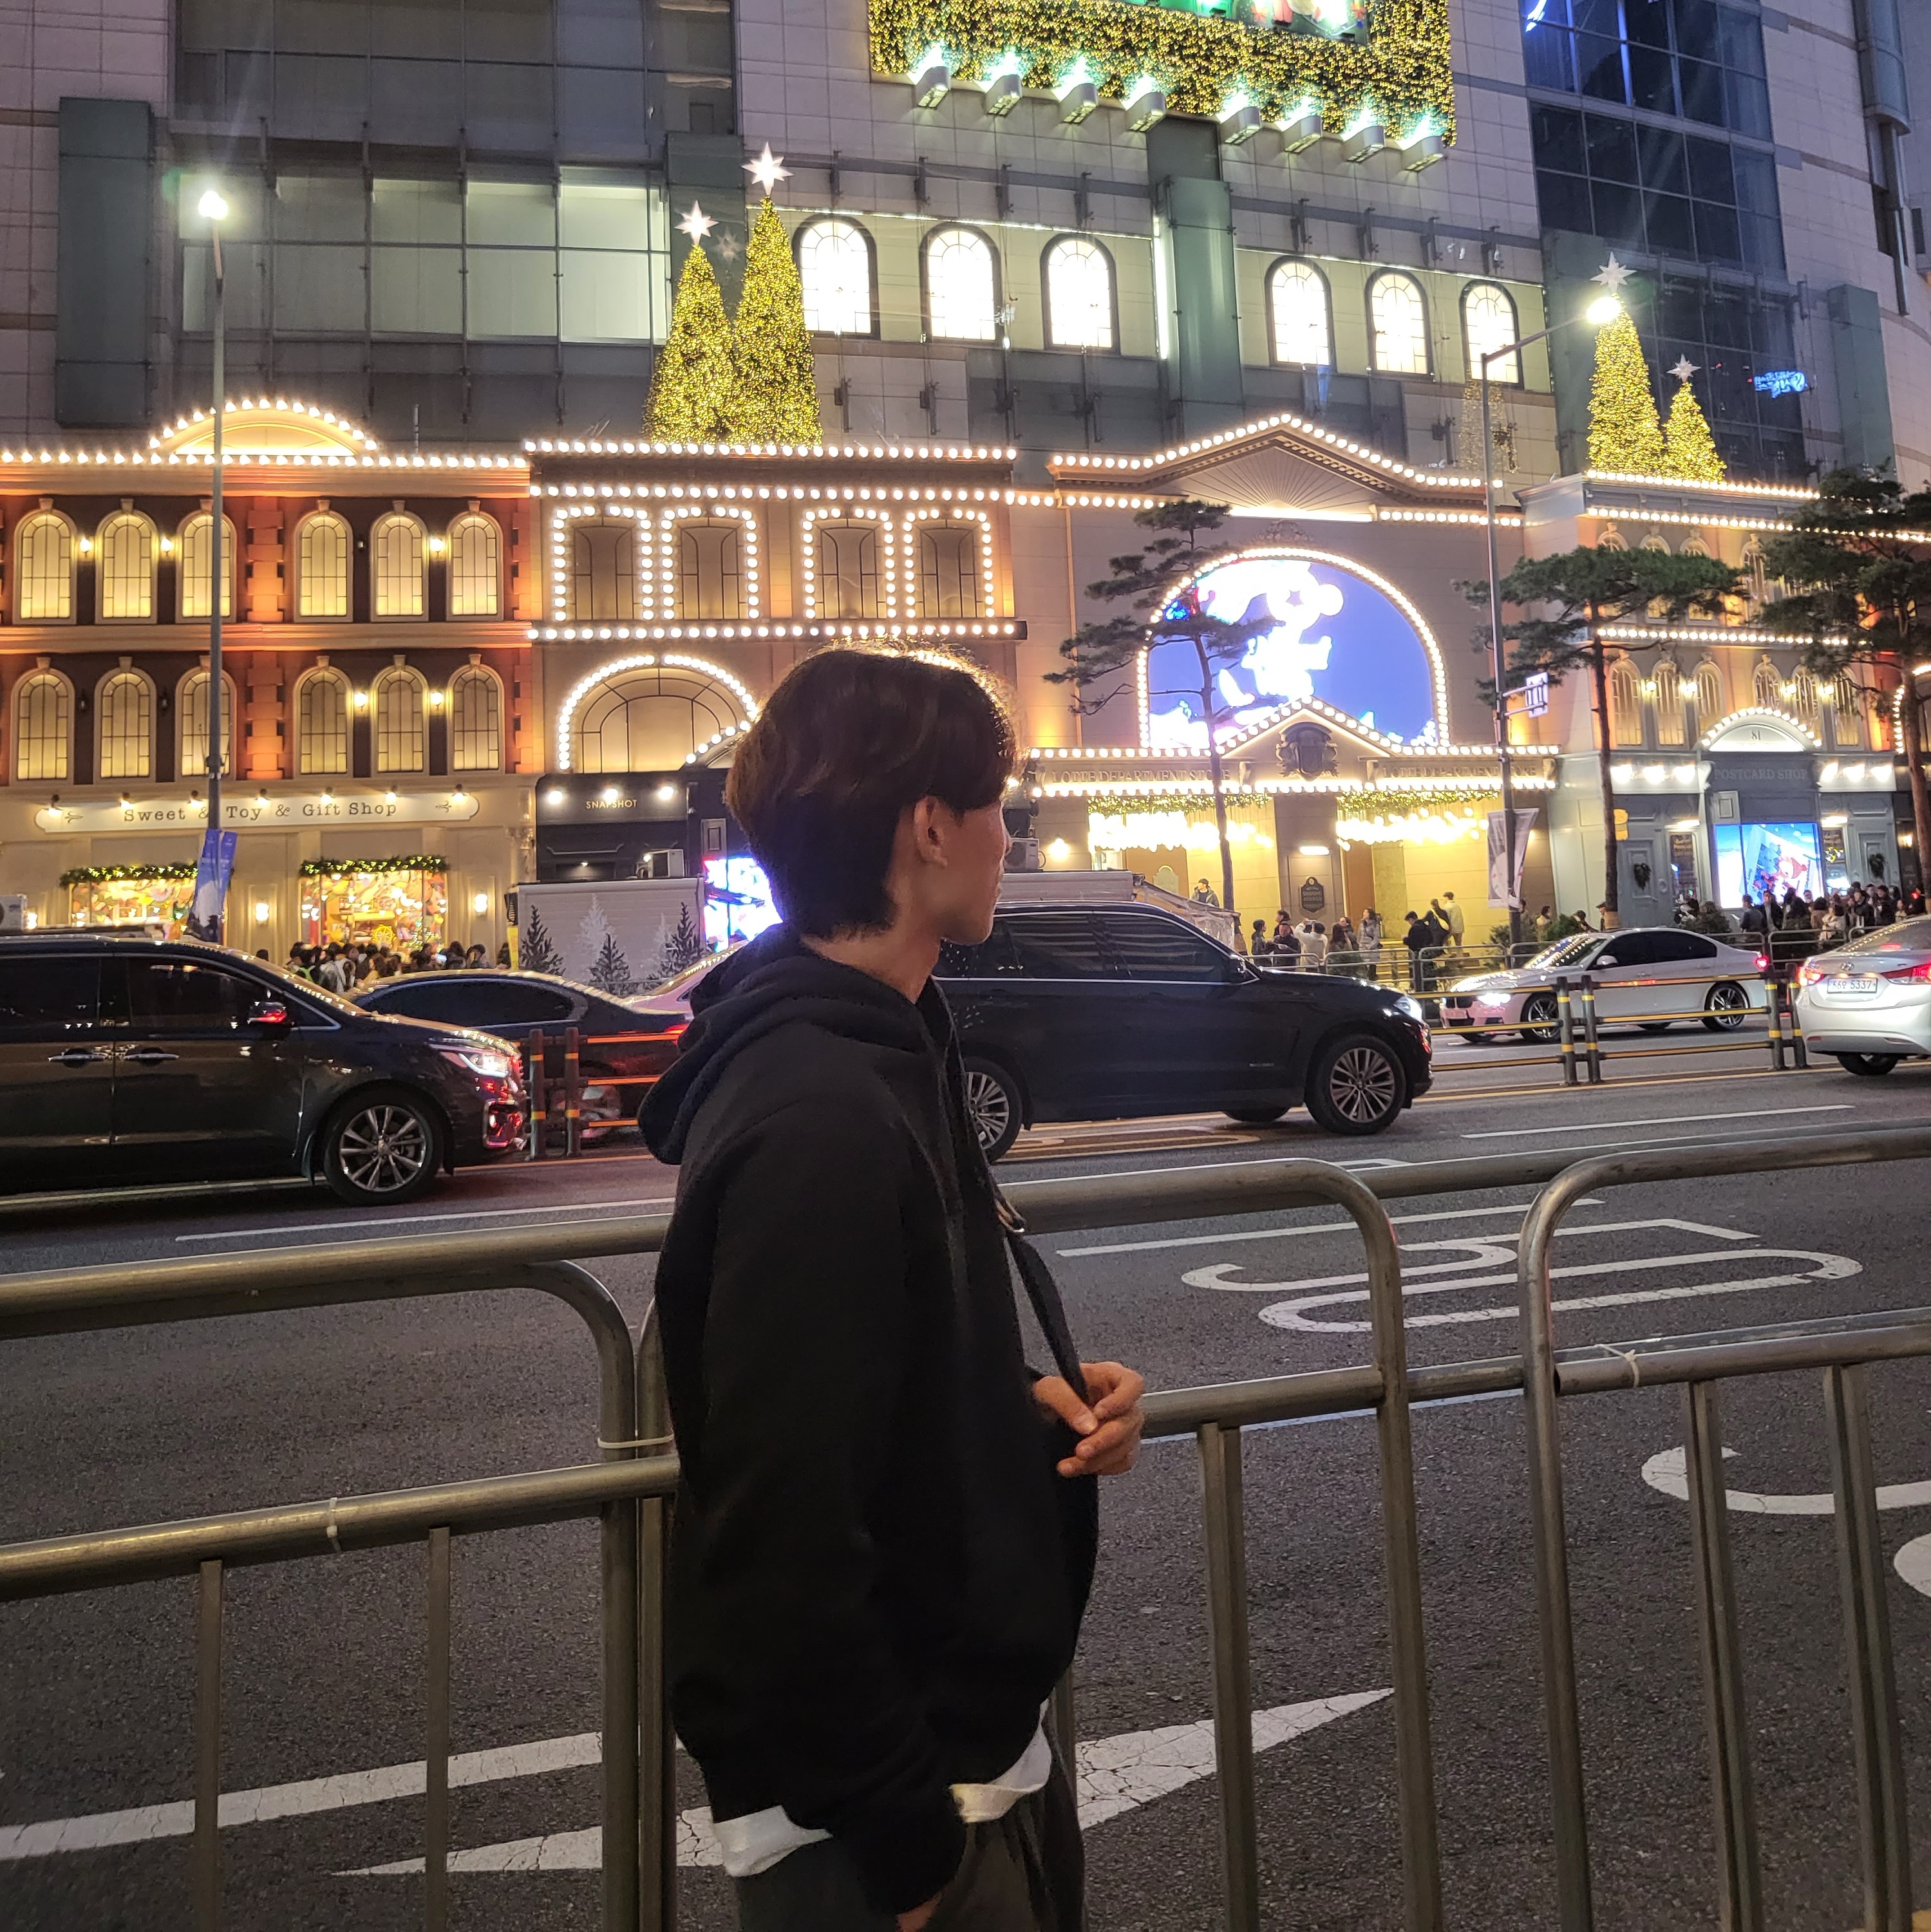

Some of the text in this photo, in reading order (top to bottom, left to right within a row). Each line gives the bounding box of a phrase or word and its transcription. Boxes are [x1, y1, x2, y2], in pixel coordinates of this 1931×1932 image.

[1751, 729, 1761, 740] 81
[1053, 769, 1230, 782] LOTTE DEPARTMENT STOE
[1715, 769, 1807, 780] POSTCARD SHOP
[586, 800, 637, 809] SNAPSHOT
[124, 807, 185, 821] Sweet
[226, 805, 262, 821] Toy
[276, 804, 290, 817] &
[303, 803, 341, 816] Gift
[349, 802, 397, 816] Shop
[1850, 980, 1872, 989] 5337
